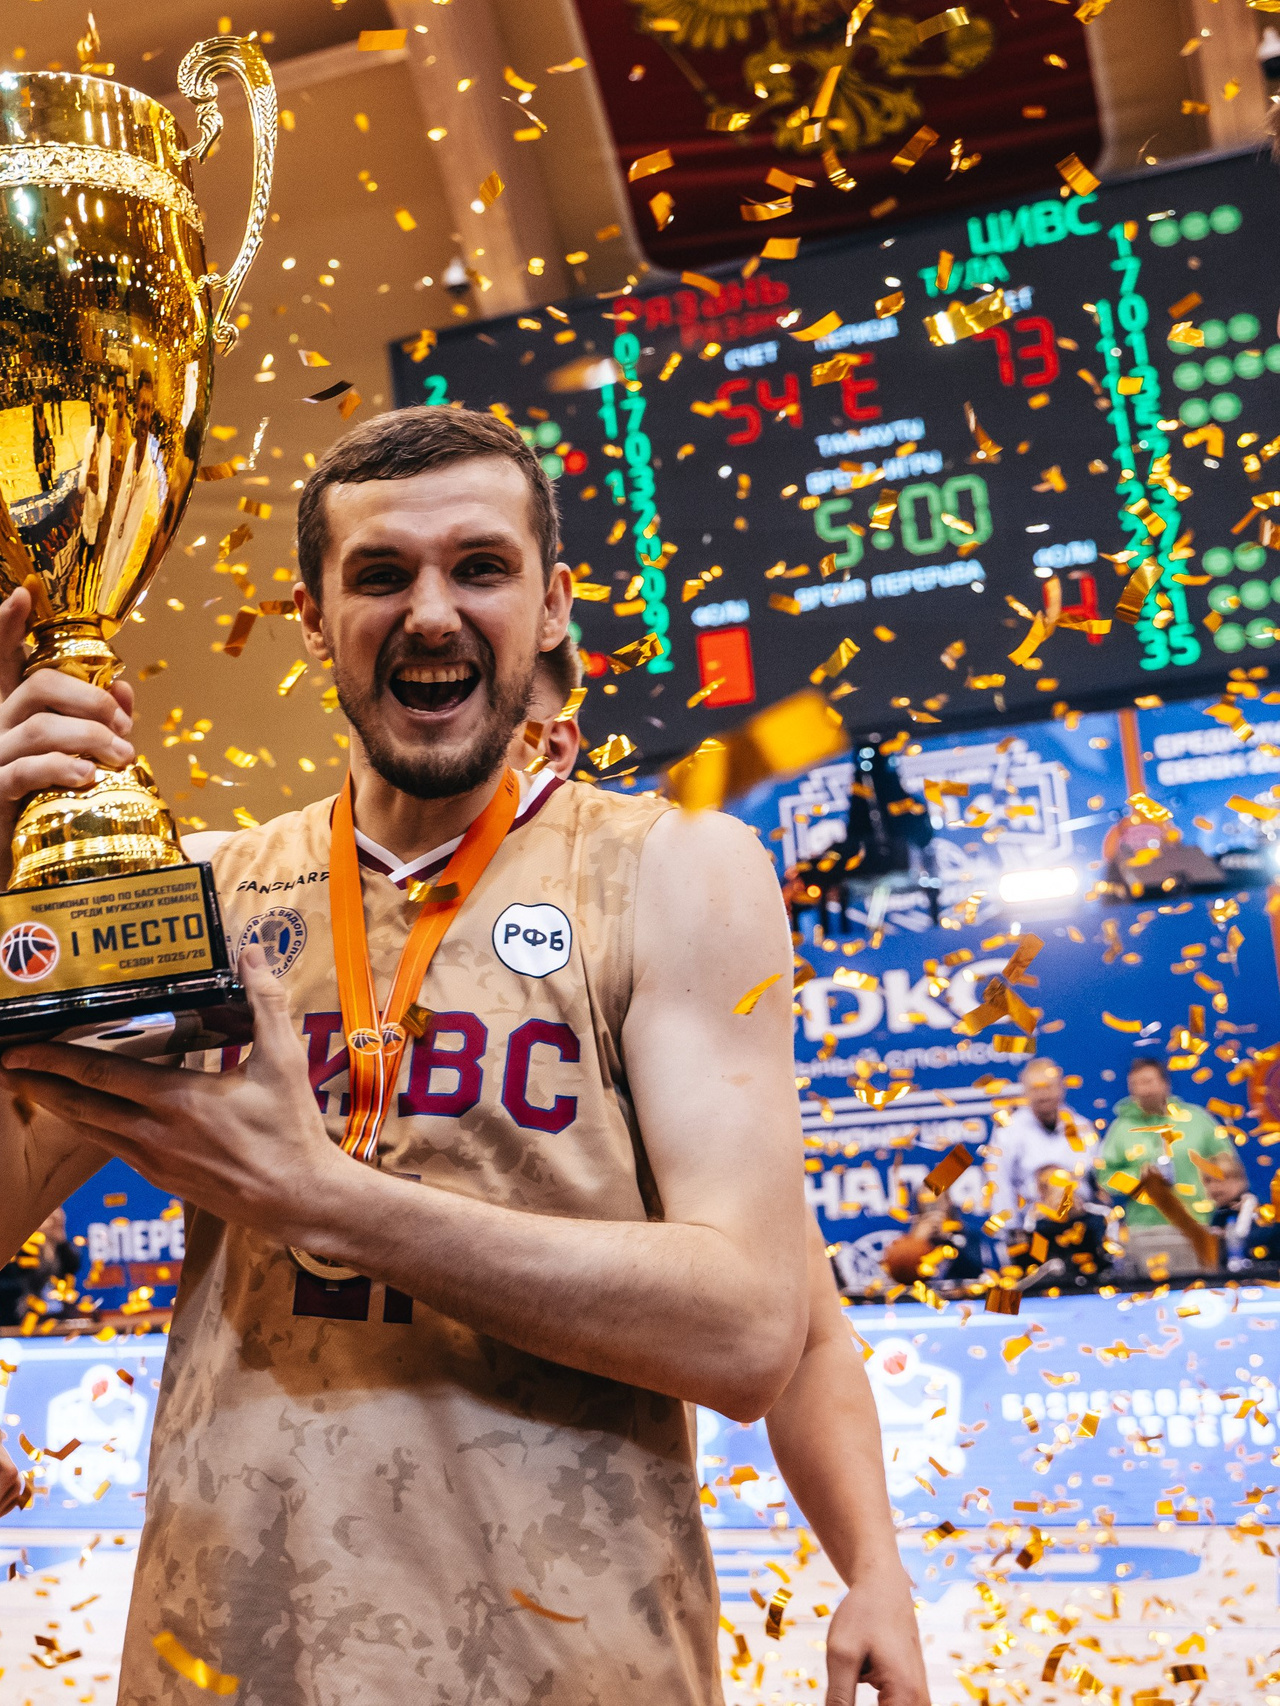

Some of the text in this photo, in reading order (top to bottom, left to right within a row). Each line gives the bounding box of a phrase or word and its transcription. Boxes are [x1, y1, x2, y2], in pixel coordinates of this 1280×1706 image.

[967, 193, 1102, 256] ЦИВС
[972, 315, 1061, 388] 73
[715, 371, 804, 446] 54
[31, 881, 198, 913] ЧЕМПИОНАТ ЦФО ПО БАСКЕТБОЛУ
[70, 892, 200, 920] СРЕДИ МУЖСКИХ КОМАНД
[92, 913, 205, 954] МЕСТО
[504, 922, 565, 952] РФБ
[119, 948, 206, 969] СЕЗОН 2025/26
